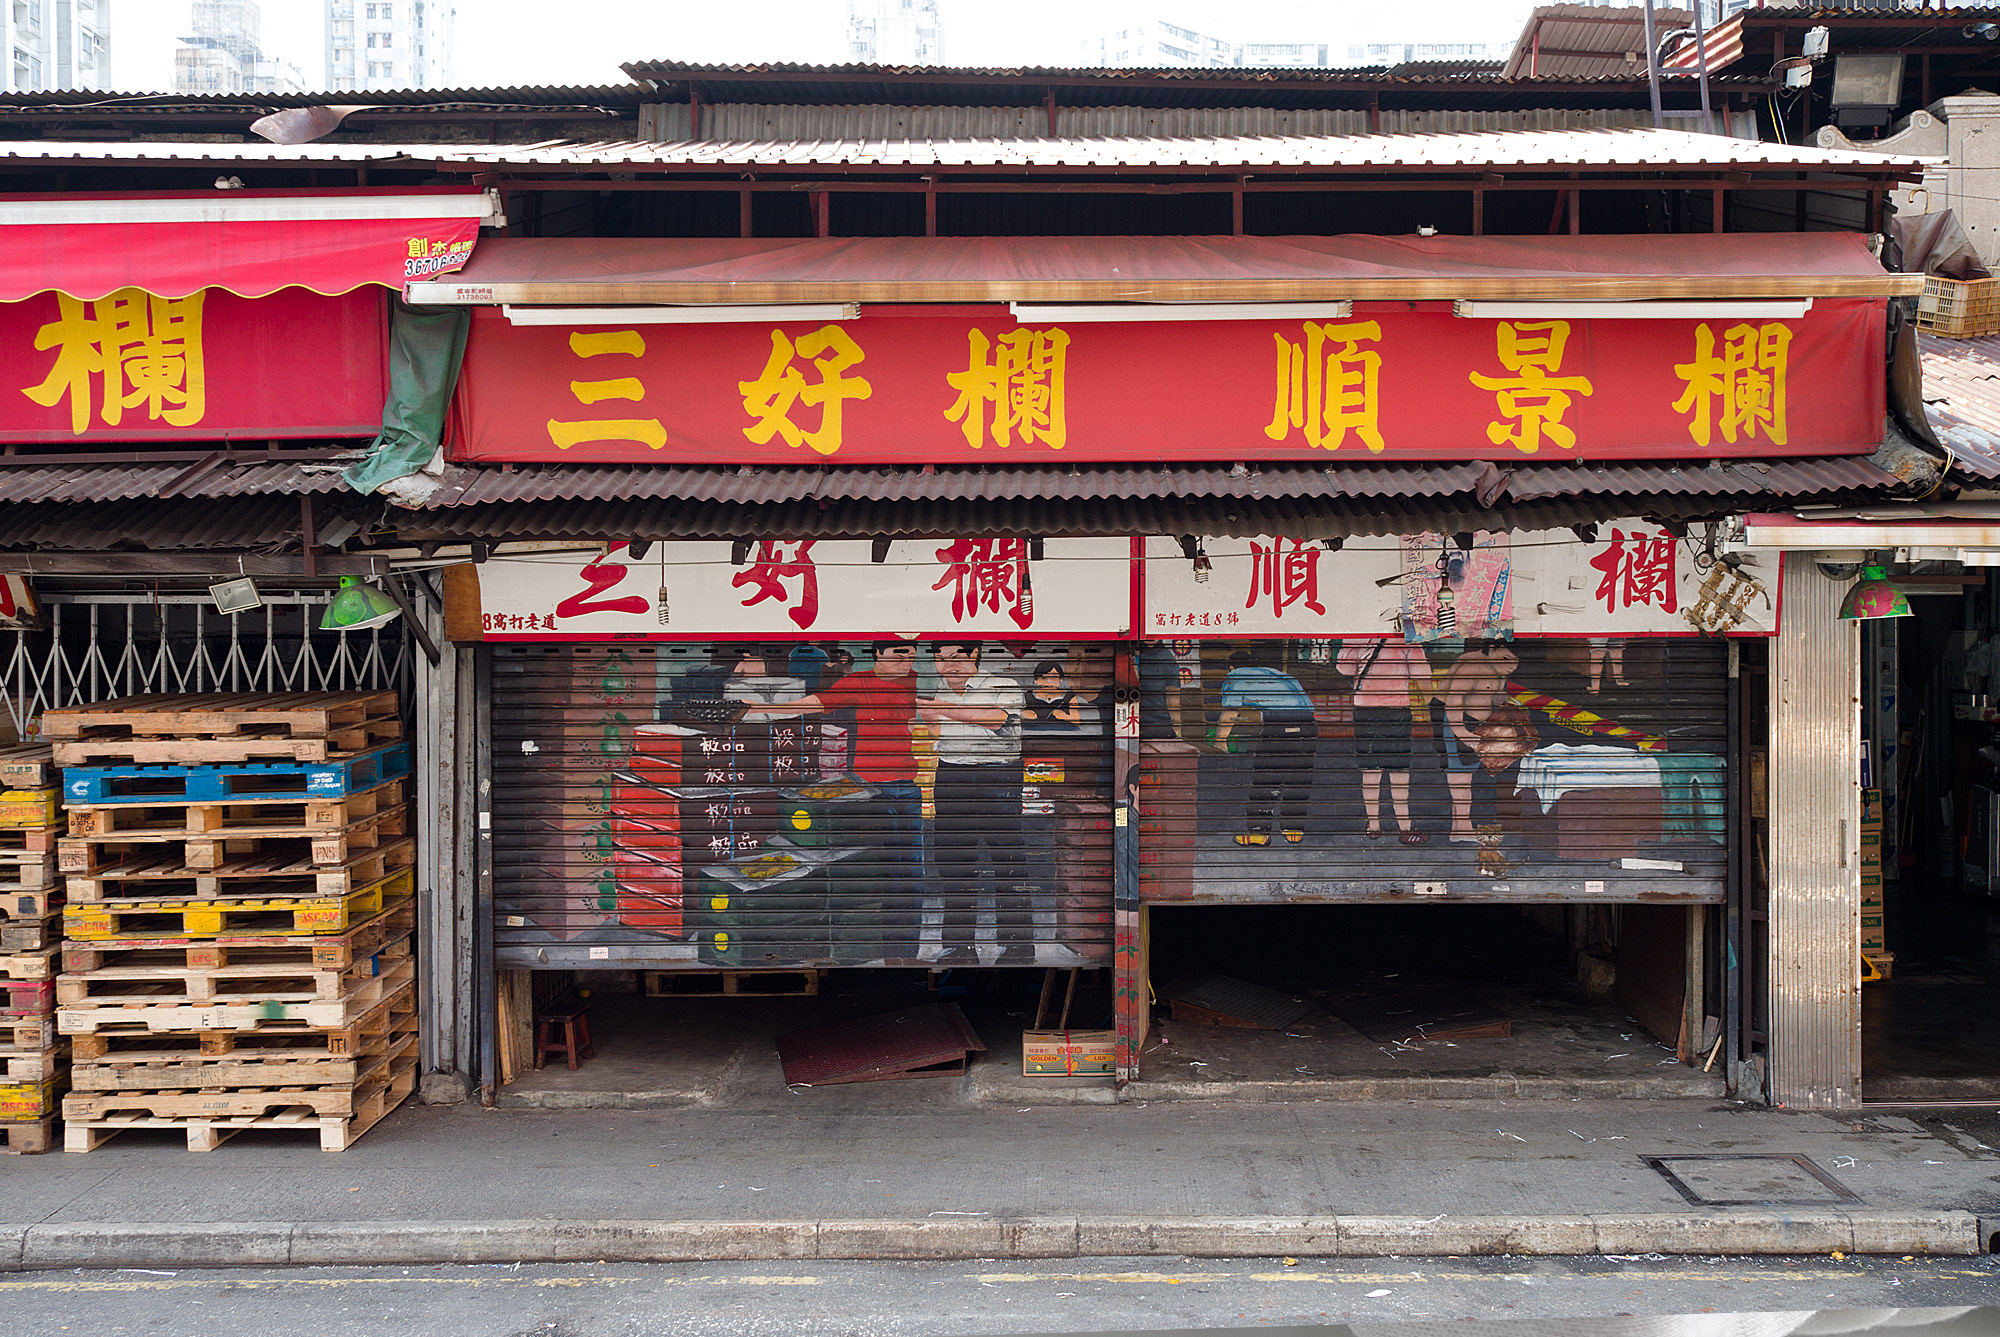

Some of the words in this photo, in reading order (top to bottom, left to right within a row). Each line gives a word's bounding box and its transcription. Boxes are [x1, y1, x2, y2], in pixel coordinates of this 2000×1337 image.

[20, 289, 206, 435] 欄
[547, 323, 1071, 455] 三好欄
[1263, 319, 1794, 455] 順景欄
[1155, 612, 1240, 627] 窩打老道8號
[315, 845, 337, 860] PNS
[192, 953, 212, 963] LFC
